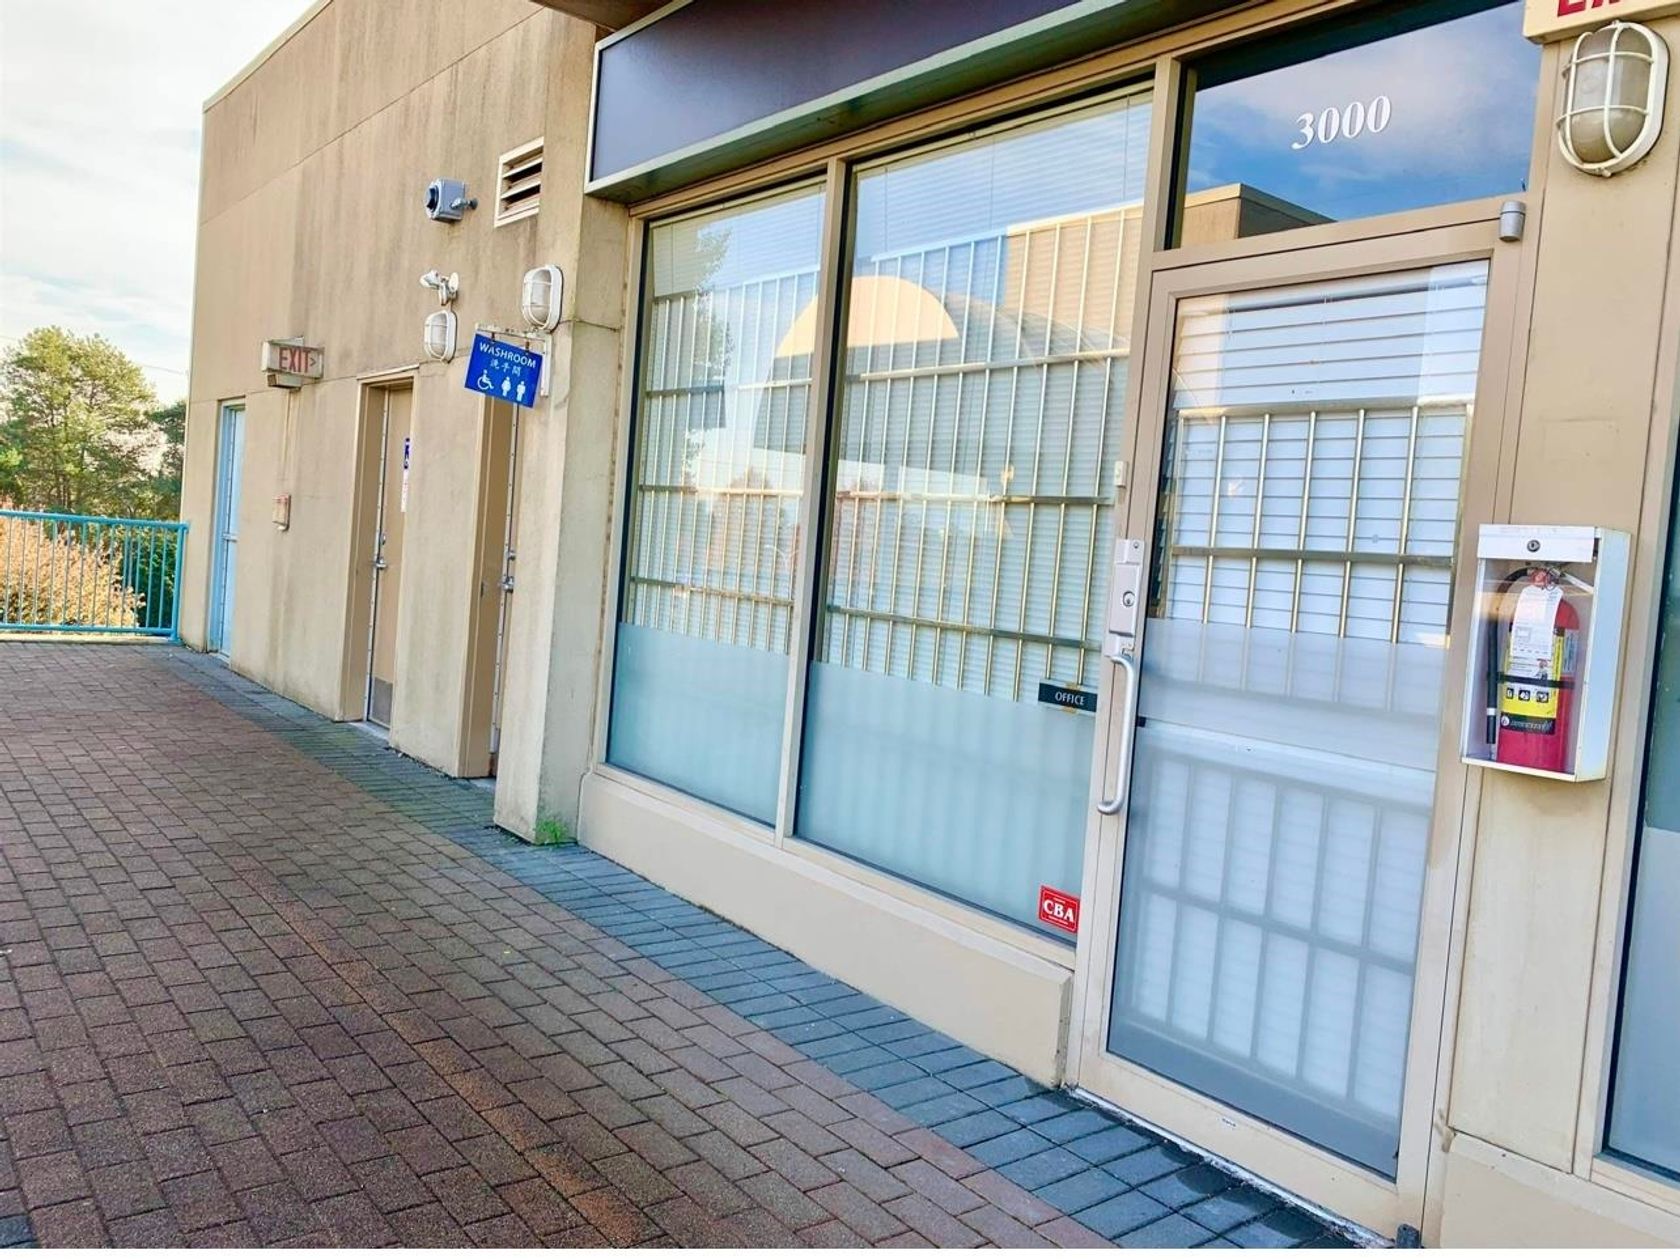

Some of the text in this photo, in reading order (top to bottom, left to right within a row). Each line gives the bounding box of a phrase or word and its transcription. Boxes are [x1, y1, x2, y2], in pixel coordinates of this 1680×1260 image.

[1291, 95, 1391, 150] 3000
[279, 347, 310, 373] EXIT
[480, 342, 537, 368] WASHROOM
[1055, 691, 1085, 706] OFFICE
[1043, 899, 1074, 923] CBA
